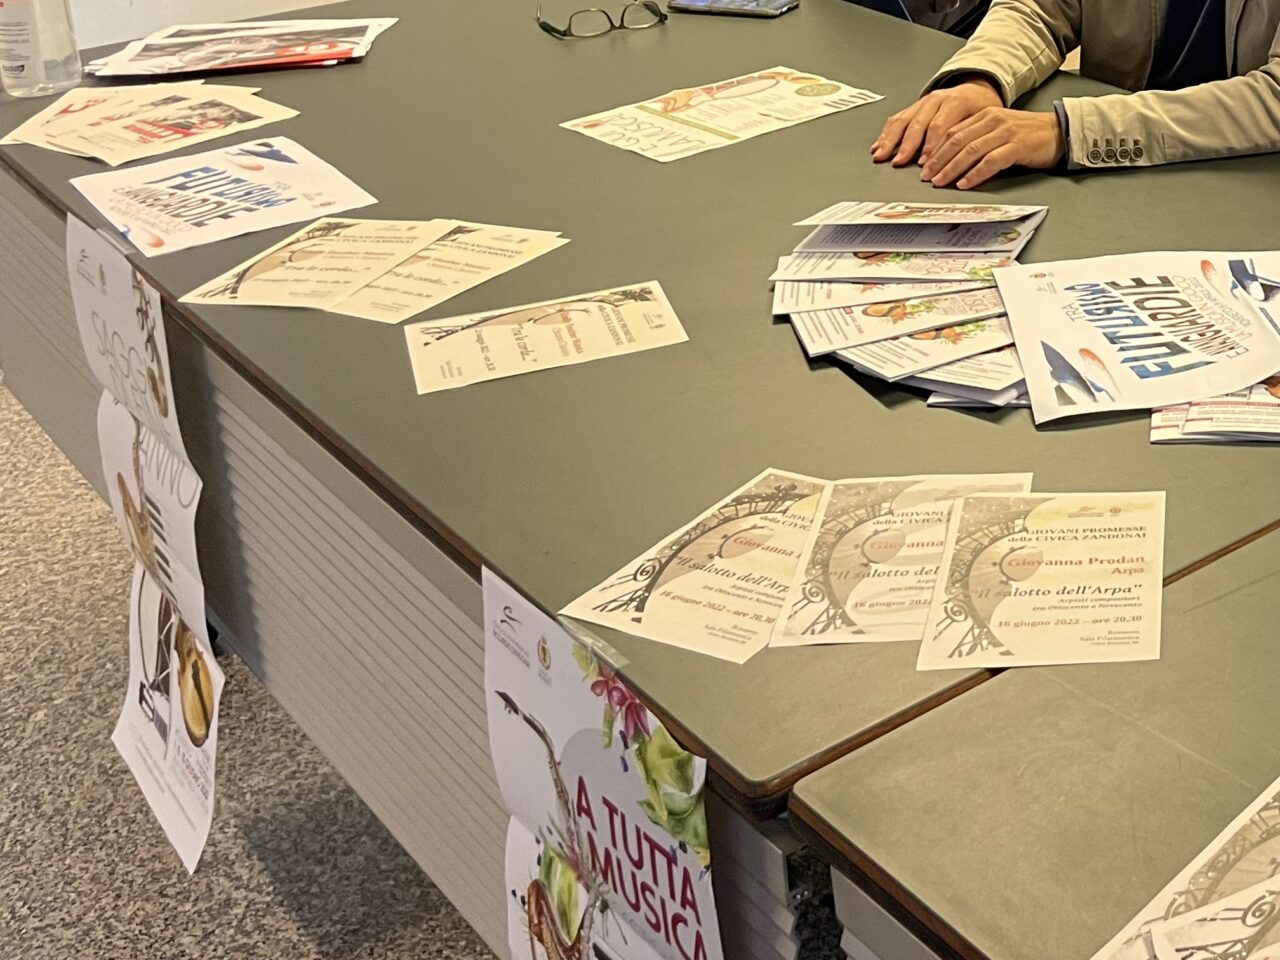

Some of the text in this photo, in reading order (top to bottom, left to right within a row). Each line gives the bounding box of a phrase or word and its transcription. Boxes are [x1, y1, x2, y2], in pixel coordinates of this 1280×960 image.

[1061, 302, 1084, 322] TRA
[1104, 275, 1240, 357] AVANGUARDIE
[1064, 282, 1218, 379] FUTURISMO
[1026, 527, 1079, 535] GIOVANI
[1035, 534, 1079, 542] CIVICA
[733, 536, 794, 557] Giovanna
[688, 560, 735, 579] salotto
[1008, 556, 1145, 567] Giovanna Prodan
[852, 568, 909, 579] salotto
[1111, 567, 1145, 576] Arpa
[999, 587, 1051, 597] salotto
[670, 593, 702, 606] giugno
[702, 600, 726, 611] 2022
[733, 609, 749, 618] ore
[1013, 620, 1051, 628] giugno
[576, 775, 702, 924] A TUTTA
[587, 832, 710, 960] MUSICA
